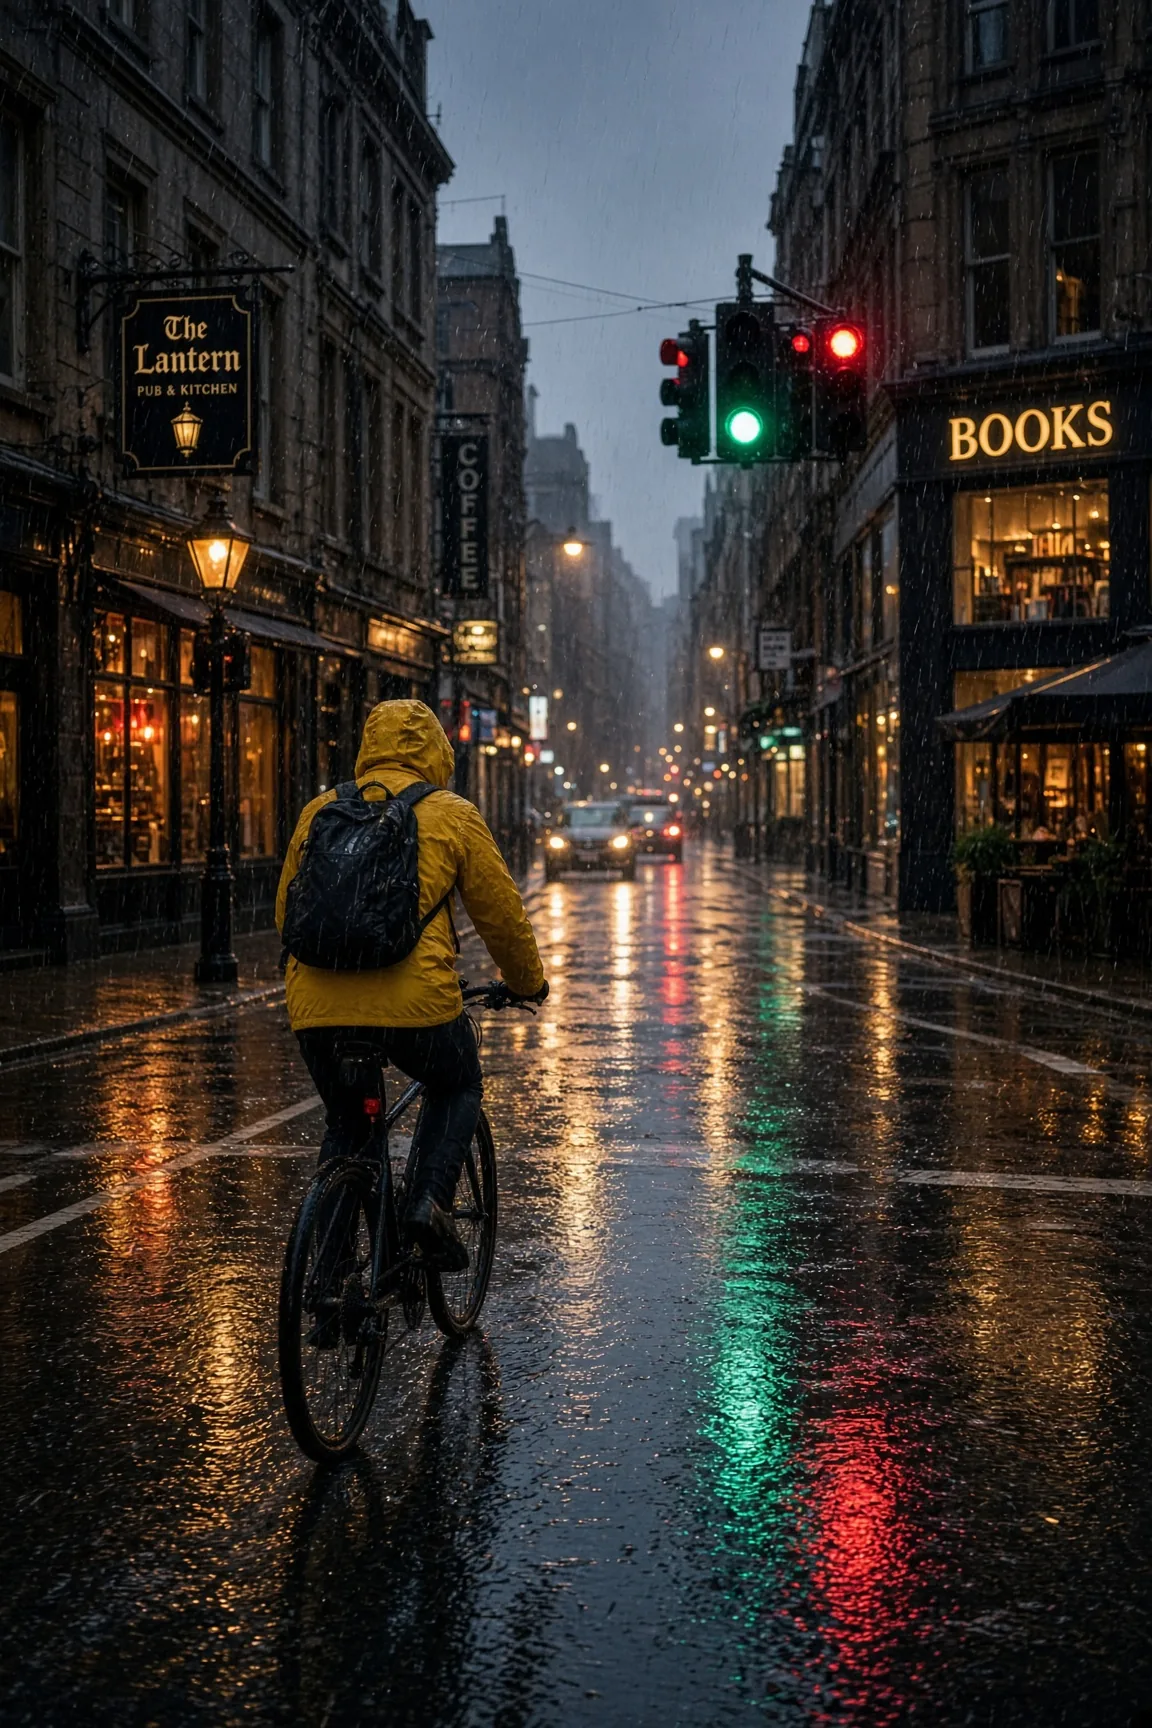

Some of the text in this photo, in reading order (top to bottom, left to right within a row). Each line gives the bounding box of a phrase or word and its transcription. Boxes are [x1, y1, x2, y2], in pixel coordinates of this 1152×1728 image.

[163, 315, 208, 341] The
[132, 343, 241, 375] Lantern
[137, 383, 237, 397] PUB & KITCHEN
[949, 400, 1113, 461] BOOKS
[457, 442, 480, 590] COFFEE
